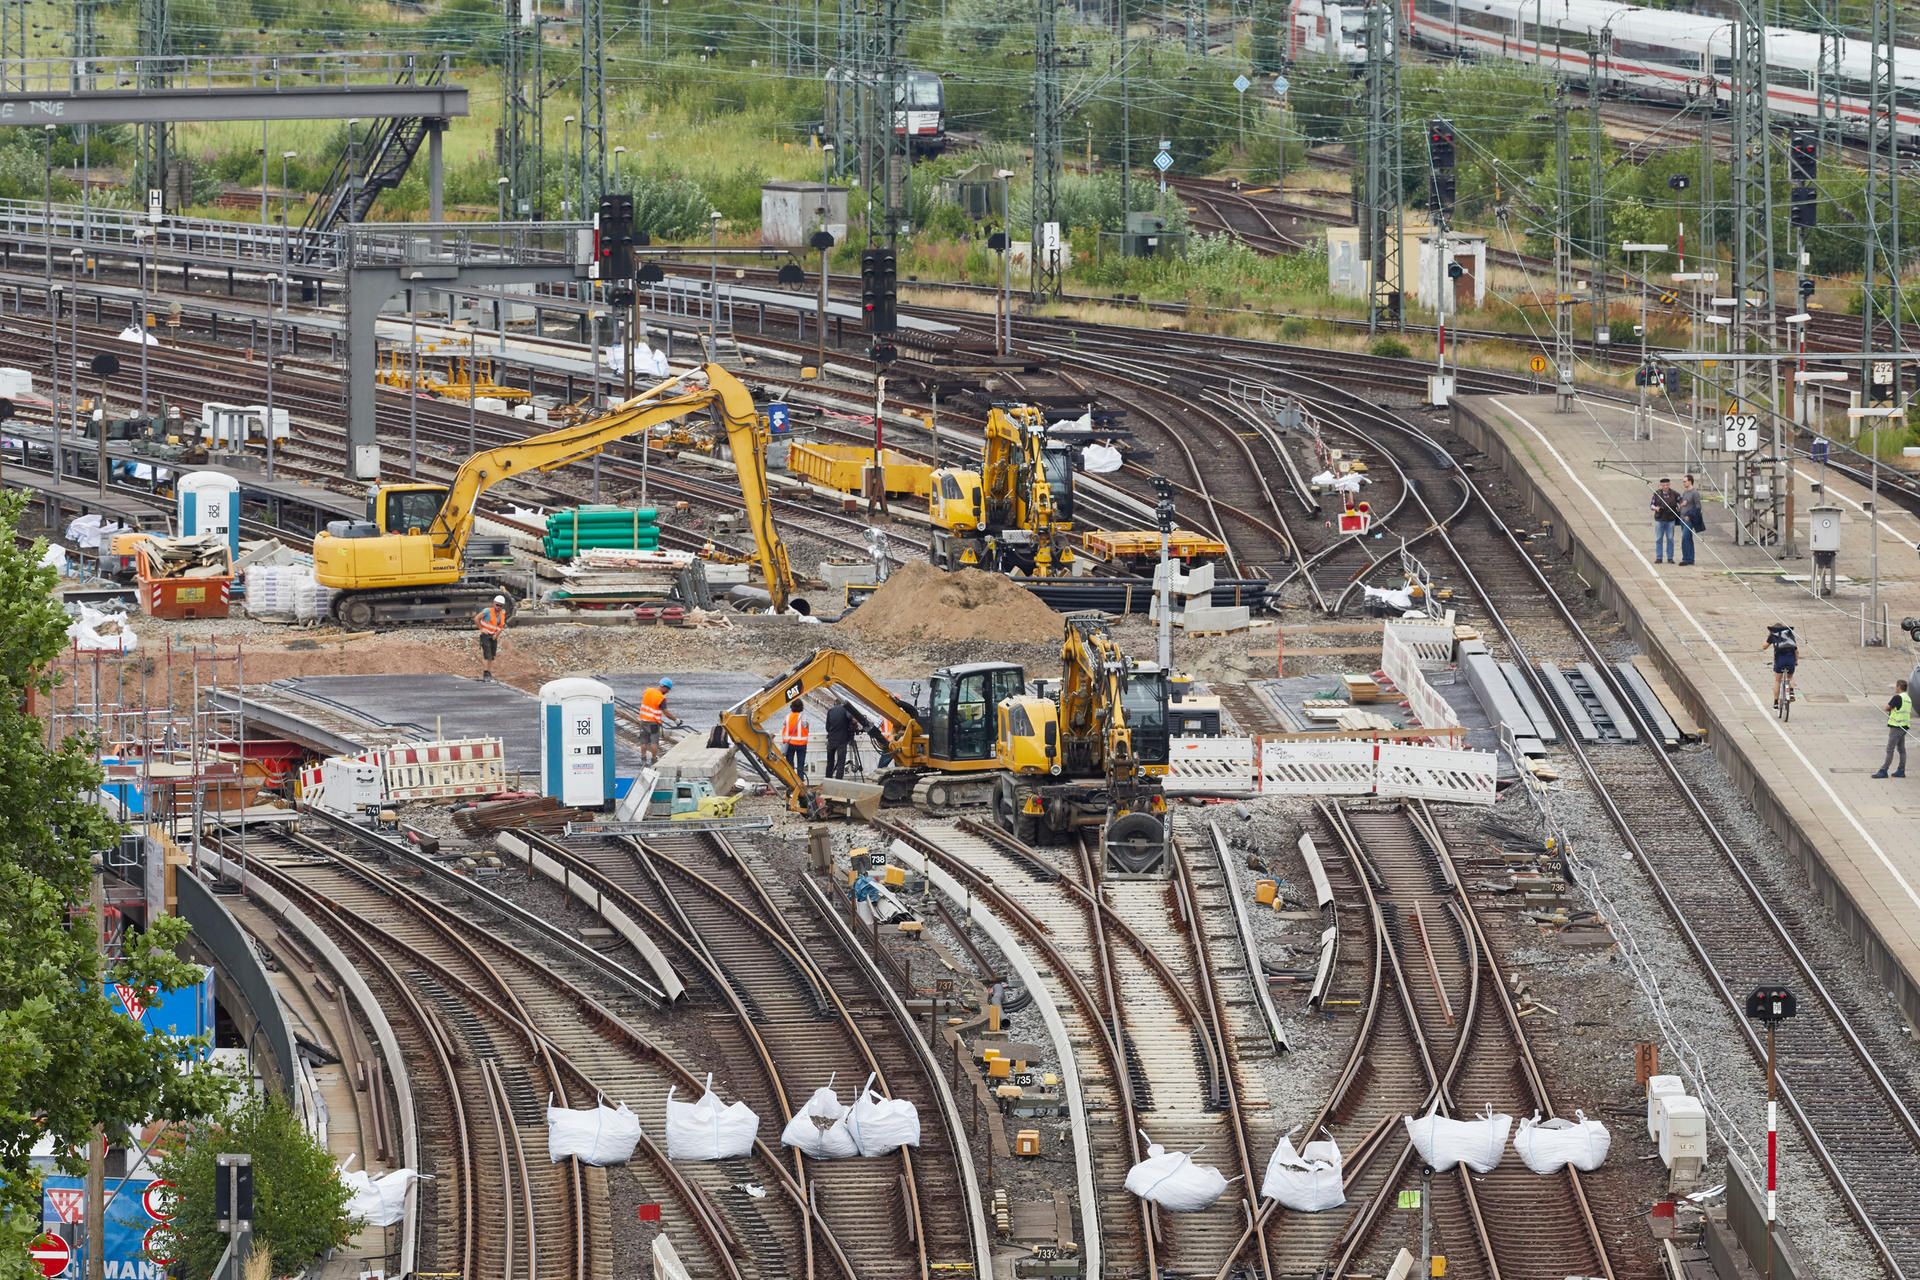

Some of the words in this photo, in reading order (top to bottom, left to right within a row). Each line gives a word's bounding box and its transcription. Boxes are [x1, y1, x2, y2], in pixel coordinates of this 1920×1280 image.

[151, 191, 160, 205] H
[1048, 236, 1055, 247] 2
[1875, 364, 1892, 373] 292
[1881, 375, 1887, 383] 7
[1725, 416, 1757, 431] 292
[1737, 433, 1746, 447] 8
[208, 504, 220, 512] TOI
[786, 685, 801, 699] CAT
[577, 718, 591, 727] TOI
[577, 727, 591, 735] TOI
[367, 806, 379, 814] 741
[871, 855, 885, 864] 738
[1547, 862, 1561, 871] 740
[1551, 883, 1564, 892] 736
[938, 982, 952, 990] 737
[1016, 1075, 1031, 1085] 735
